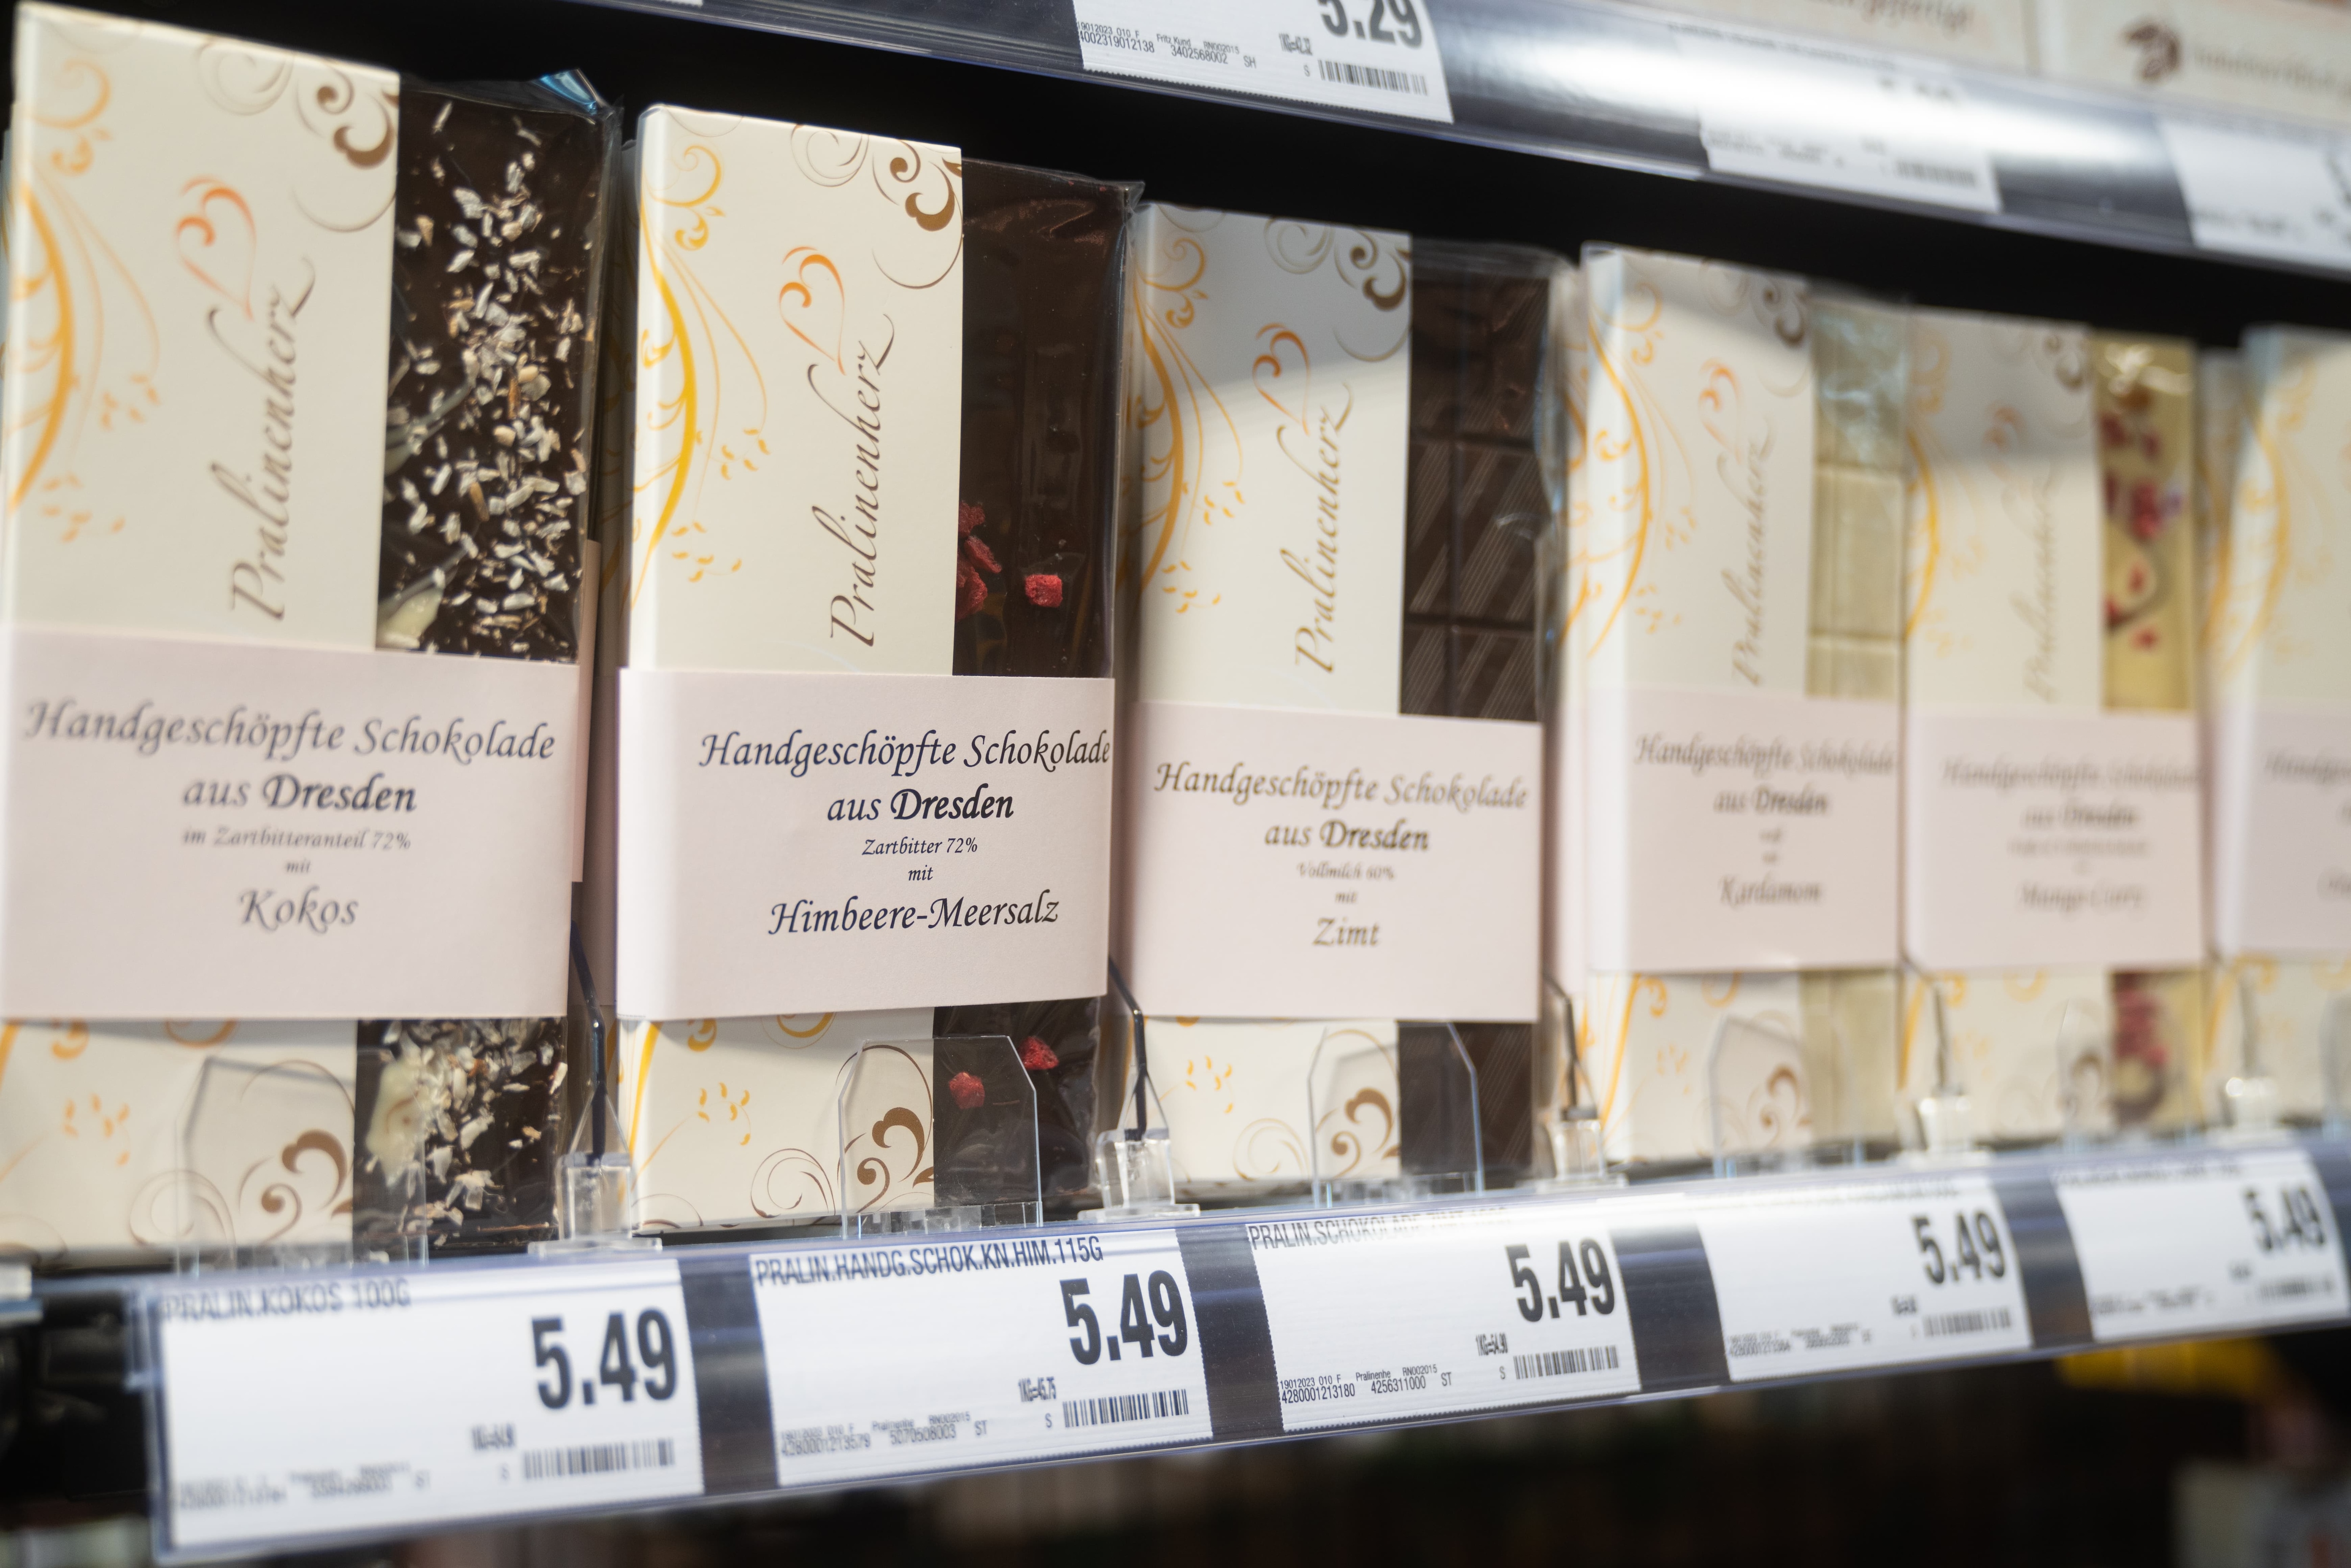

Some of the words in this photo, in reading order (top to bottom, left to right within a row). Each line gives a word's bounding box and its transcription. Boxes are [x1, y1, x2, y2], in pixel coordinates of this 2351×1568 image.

[1077, 21, 1112, 35] 19012023
[1157, 33, 1171, 45] Fritz
[1175, 37, 1191, 47] Kund
[1317, 0, 1423, 49] 5.29
[1079, 30, 1155, 54] 4002319012138
[1170, 44, 1229, 64] 3402568002
[1244, 55, 1257, 69] SH
[1303, 65, 1310, 77] S
[807, 314, 894, 647] Pralinenherz
[1276, 380, 1354, 673] Pralinenherz
[25, 699, 345, 761] Handgeschöpfte
[354, 716, 556, 764] Schokolade
[699, 729, 955, 778] Handgeschöpfte
[963, 729, 1110, 773] Schokolade
[183, 775, 250, 807] aus
[263, 772, 418, 813] Dresden
[827, 795, 880, 821] aus
[890, 783, 1014, 820] Dresden
[1154, 760, 1378, 810] Handgeschöpfte
[1383, 772, 1528, 813] Schokolade
[371, 830, 411, 851] 72%
[861, 836, 942, 856] Zartbitter
[947, 836, 978, 855] 72%
[1265, 824, 1311, 847] aus
[1319, 818, 1429, 851] Dresden
[284, 858, 311, 875] mit
[907, 865, 933, 882] mit
[239, 886, 359, 935] Kokos
[768, 889, 1060, 936] Himbeere-Meersalz
[1334, 889, 1358, 905] mit
[1312, 917, 1380, 947] Zimt
[1911, 1211, 2006, 1284] 5.49
[1505, 1238, 1616, 1323] 5.49
[1060, 1269, 1189, 1366] 5.49
[531, 1308, 678, 1410] 5.49
[1280, 1376, 1315, 1390] 19012023
[1318, 1375, 1333, 1386] 010
[1337, 1374, 1341, 1384] F
[1356, 1369, 1391, 1382] Pralinenhe
[1402, 1364, 1437, 1377] RN002015
[1281, 1383, 1356, 1404] 4280001213180
[1371, 1375, 1426, 1394] 4256311000
[1441, 1371, 1452, 1387] ST
[1499, 1365, 1506, 1380] S
[974, 1419, 988, 1436] ST
[1045, 1413, 1052, 1428] S
